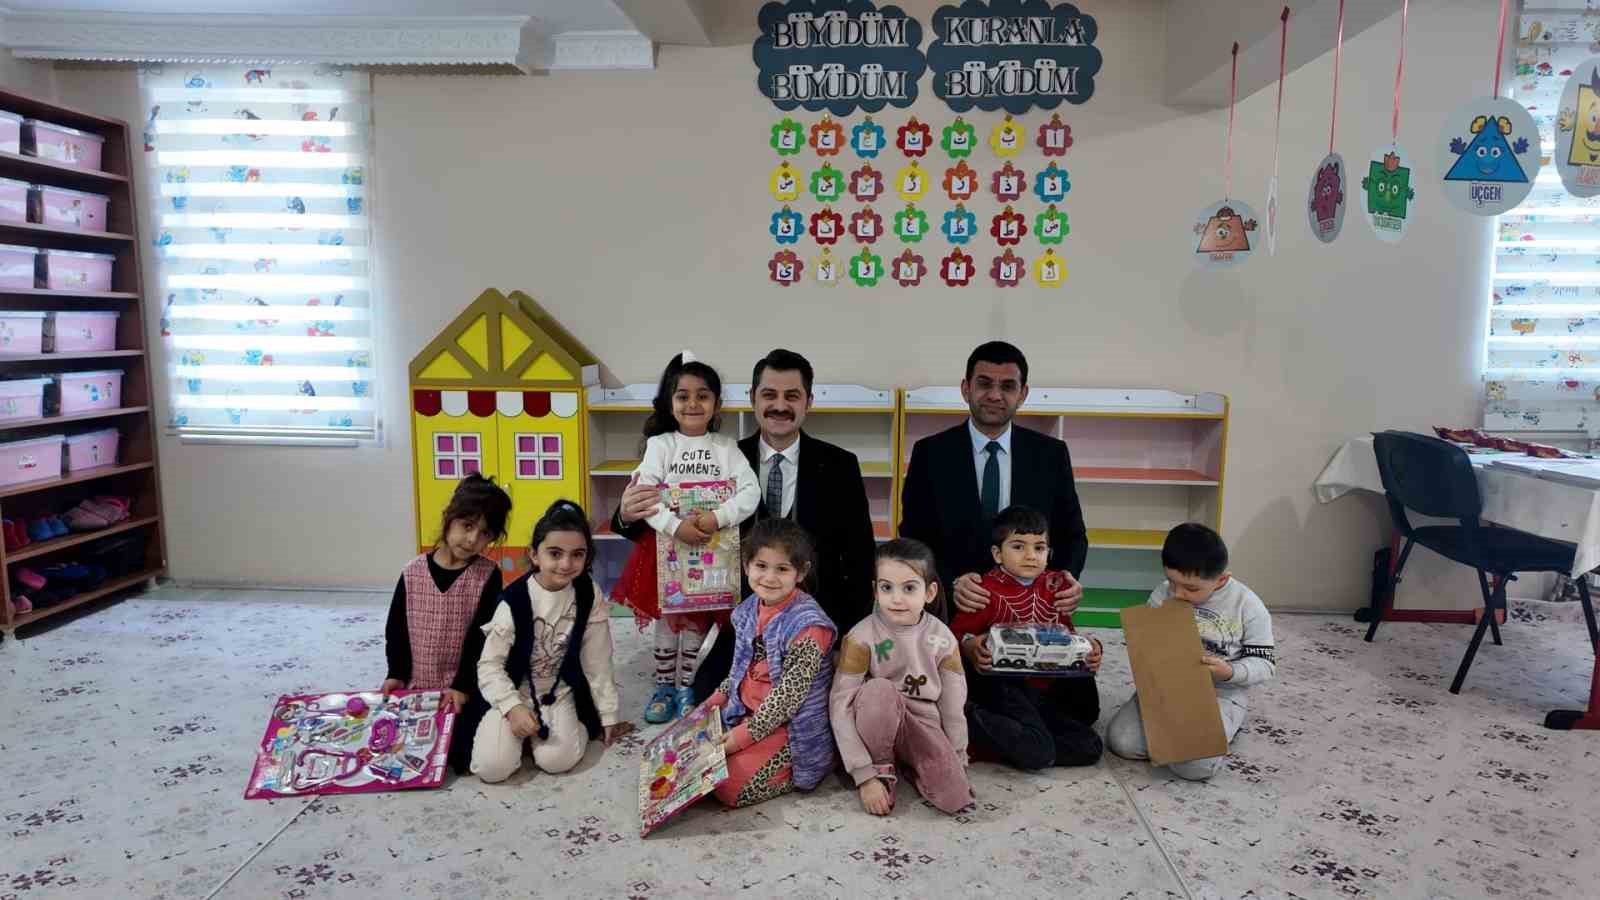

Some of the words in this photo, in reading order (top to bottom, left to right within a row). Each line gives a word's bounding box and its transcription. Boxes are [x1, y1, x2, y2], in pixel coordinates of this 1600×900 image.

[772, 10, 909, 48] BÜYÜDÜM
[943, 16, 1087, 46] KURANLA
[771, 63, 908, 100] BÜYÜDÜM
[944, 58, 1080, 98] BÜYÜDÜM
[668, 462, 721, 476] MOMENTS
[681, 449, 711, 461] CUTE
